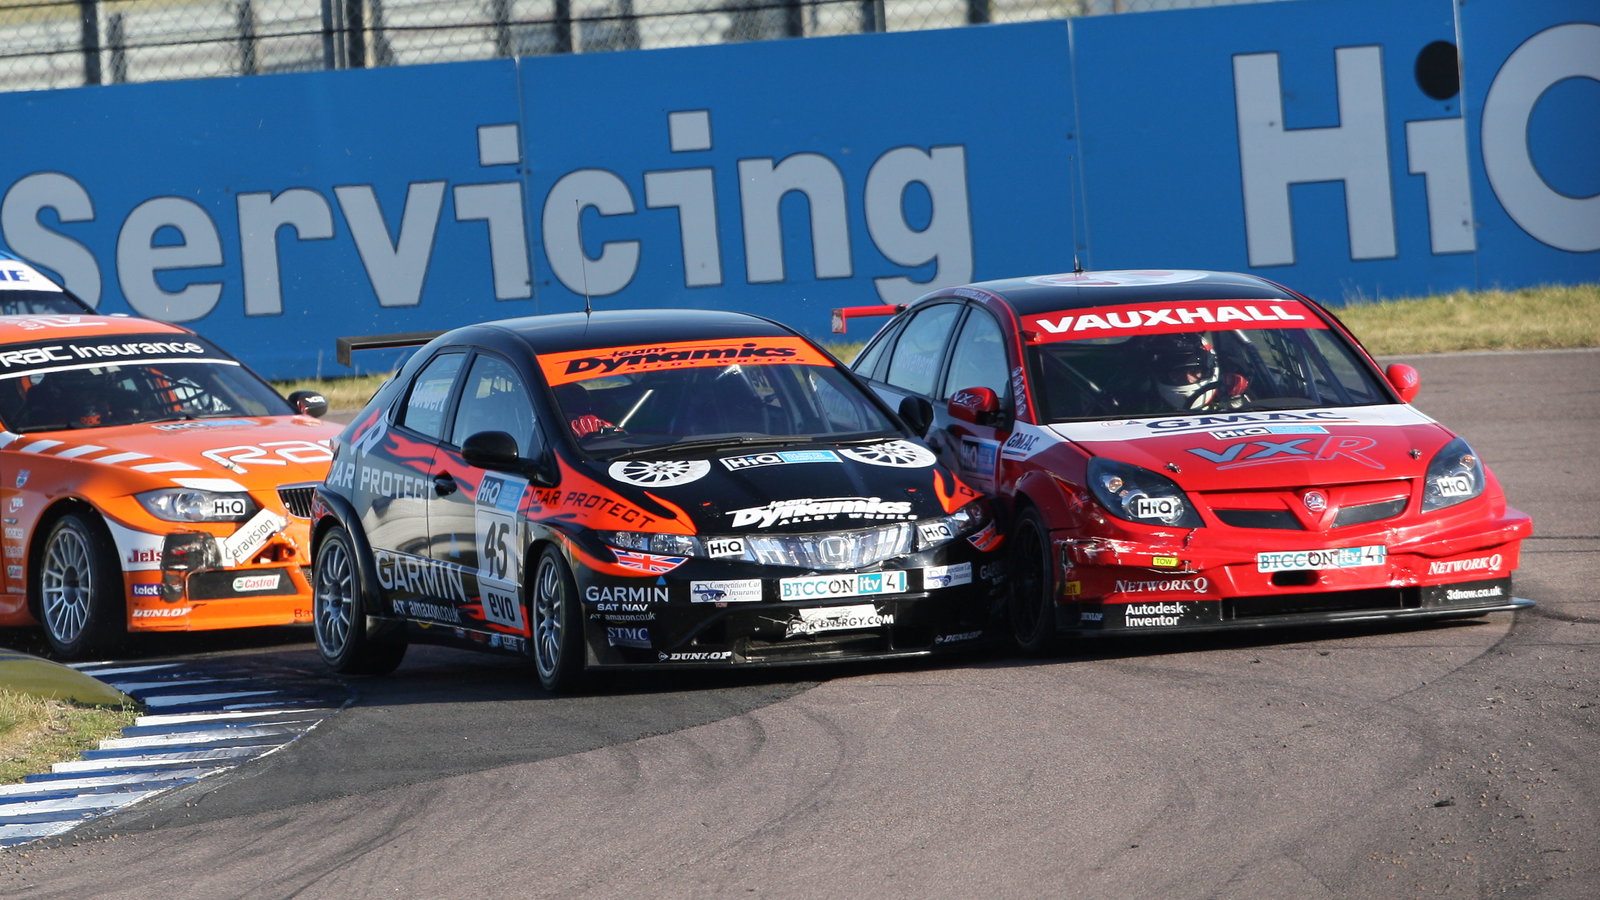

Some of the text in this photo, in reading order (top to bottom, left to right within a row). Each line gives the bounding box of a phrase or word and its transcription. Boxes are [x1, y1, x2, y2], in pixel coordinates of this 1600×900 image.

[0, 110, 977, 323] Servicing
[1036, 305, 1305, 334] VAUXHALL
[70, 342, 205, 358] Insurance
[613, 347, 667, 358] team
[564, 343, 797, 375] Dynamics
[1146, 411, 1350, 429] GMAC
[1218, 427, 1270, 438] HiQ
[1008, 432, 1040, 452] GMAC
[1187, 435, 1386, 470] VXR
[728, 454, 783, 468] HiQ
[360, 466, 437, 501] PROTECT
[477, 479, 500, 503] HiQ
[1440, 480, 1468, 494] HiQ
[213, 500, 245, 514] HiQ
[532, 490, 561, 504] CAR
[564, 491, 656, 529] PROTECT
[731, 498, 912, 528] Dynamics
[1140, 501, 1172, 515] HiQ
[777, 514, 837, 526] ALLOY
[924, 523, 952, 541] HiQ
[484, 521, 511, 580] 45
[710, 540, 743, 555] HiQ
[1155, 558, 1173, 566] TOW
[1428, 553, 1502, 575] NETWORK Q
[244, 578, 276, 589] Castrol
[375, 550, 467, 603] GARMIN
[859, 574, 881, 592] itv
[886, 573, 897, 590] 4
[728, 588, 761, 597] Insurance
[748, 581, 761, 589] Car
[1114, 576, 1208, 594] NETWORK Q
[1446, 585, 1502, 601] 3dnow.co.uk
[585, 585, 670, 603] GARMIN
[131, 607, 193, 618] DUNLOP
[393, 600, 406, 615] AT
[488, 592, 516, 623] evo
[596, 603, 649, 612] SAT NAV
[1125, 601, 1185, 616] Autodesk
[1125, 615, 1180, 628] Inventor
[607, 626, 648, 641] STMC
[670, 650, 733, 661] DUNLOP
